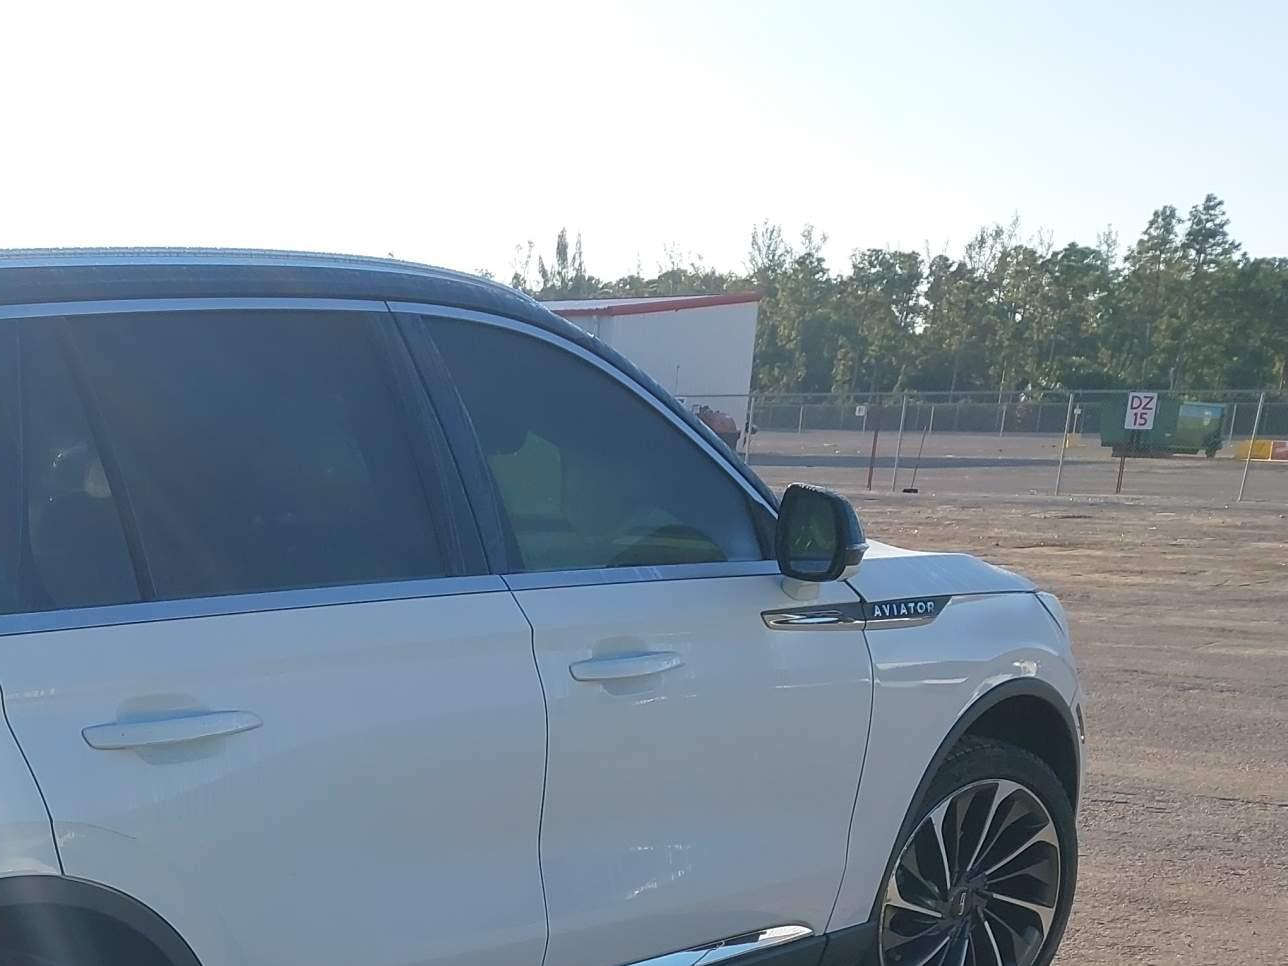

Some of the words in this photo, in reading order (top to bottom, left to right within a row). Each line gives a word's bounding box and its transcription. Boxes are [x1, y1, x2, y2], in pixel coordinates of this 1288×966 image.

[1130, 395, 1154, 410] DZ
[1133, 412, 1148, 426] 15
[873, 602, 935, 617] AVIATOR
